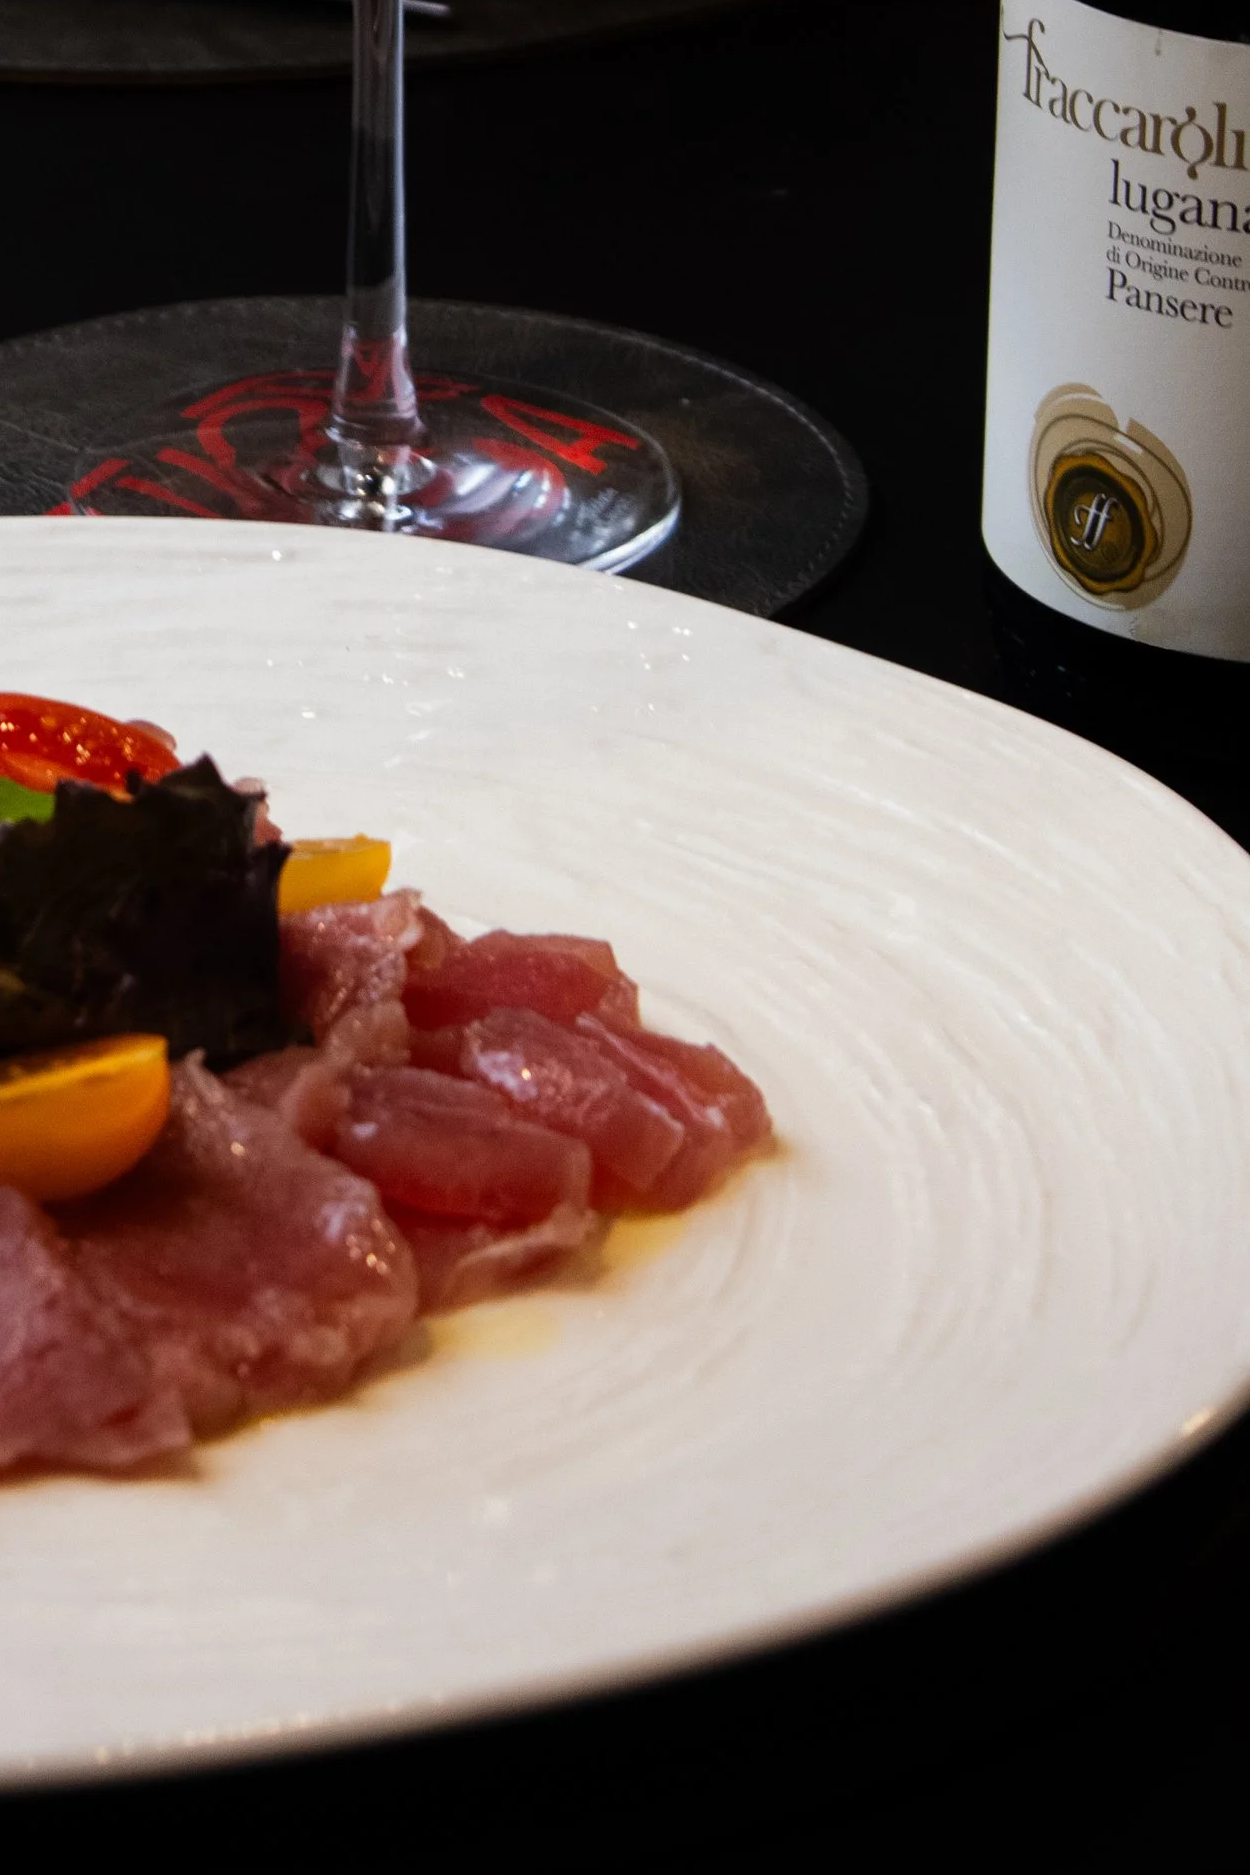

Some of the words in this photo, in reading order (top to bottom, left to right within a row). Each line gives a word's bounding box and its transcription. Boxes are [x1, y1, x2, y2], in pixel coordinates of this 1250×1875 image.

[1107, 219, 1243, 268] Denominazione
[1106, 244, 1121, 265] di
[1124, 249, 1190, 282] Origine
[1194, 266, 1250, 293] Contr
[1105, 265, 1234, 330] Pansere
